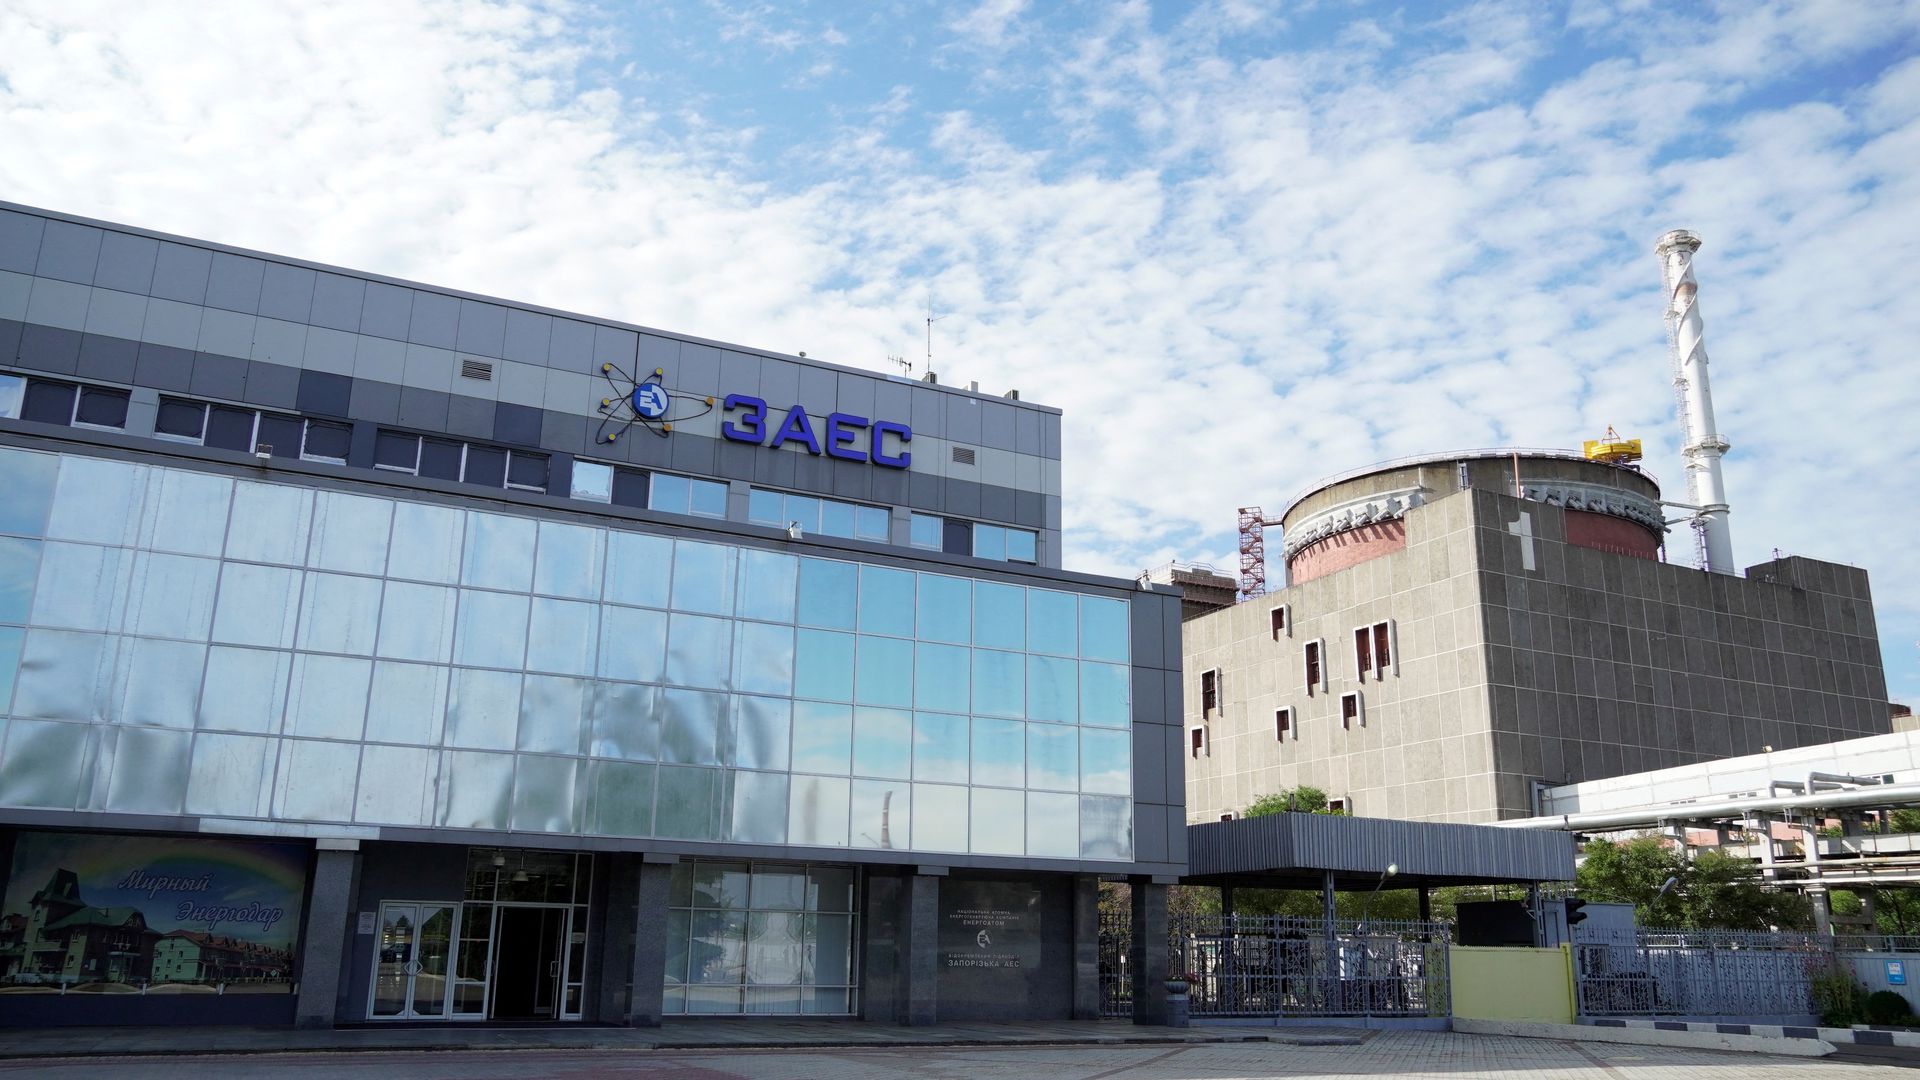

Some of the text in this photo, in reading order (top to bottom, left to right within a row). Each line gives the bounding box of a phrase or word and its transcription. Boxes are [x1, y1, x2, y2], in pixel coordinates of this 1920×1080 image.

[723, 393, 912, 469] ЗАЕС
[1508, 511, 1536, 571] 1
[119, 870, 214, 900] Мирный
[176, 901, 283, 931] Энергодар
[1004, 960, 1020, 968] АЕС
